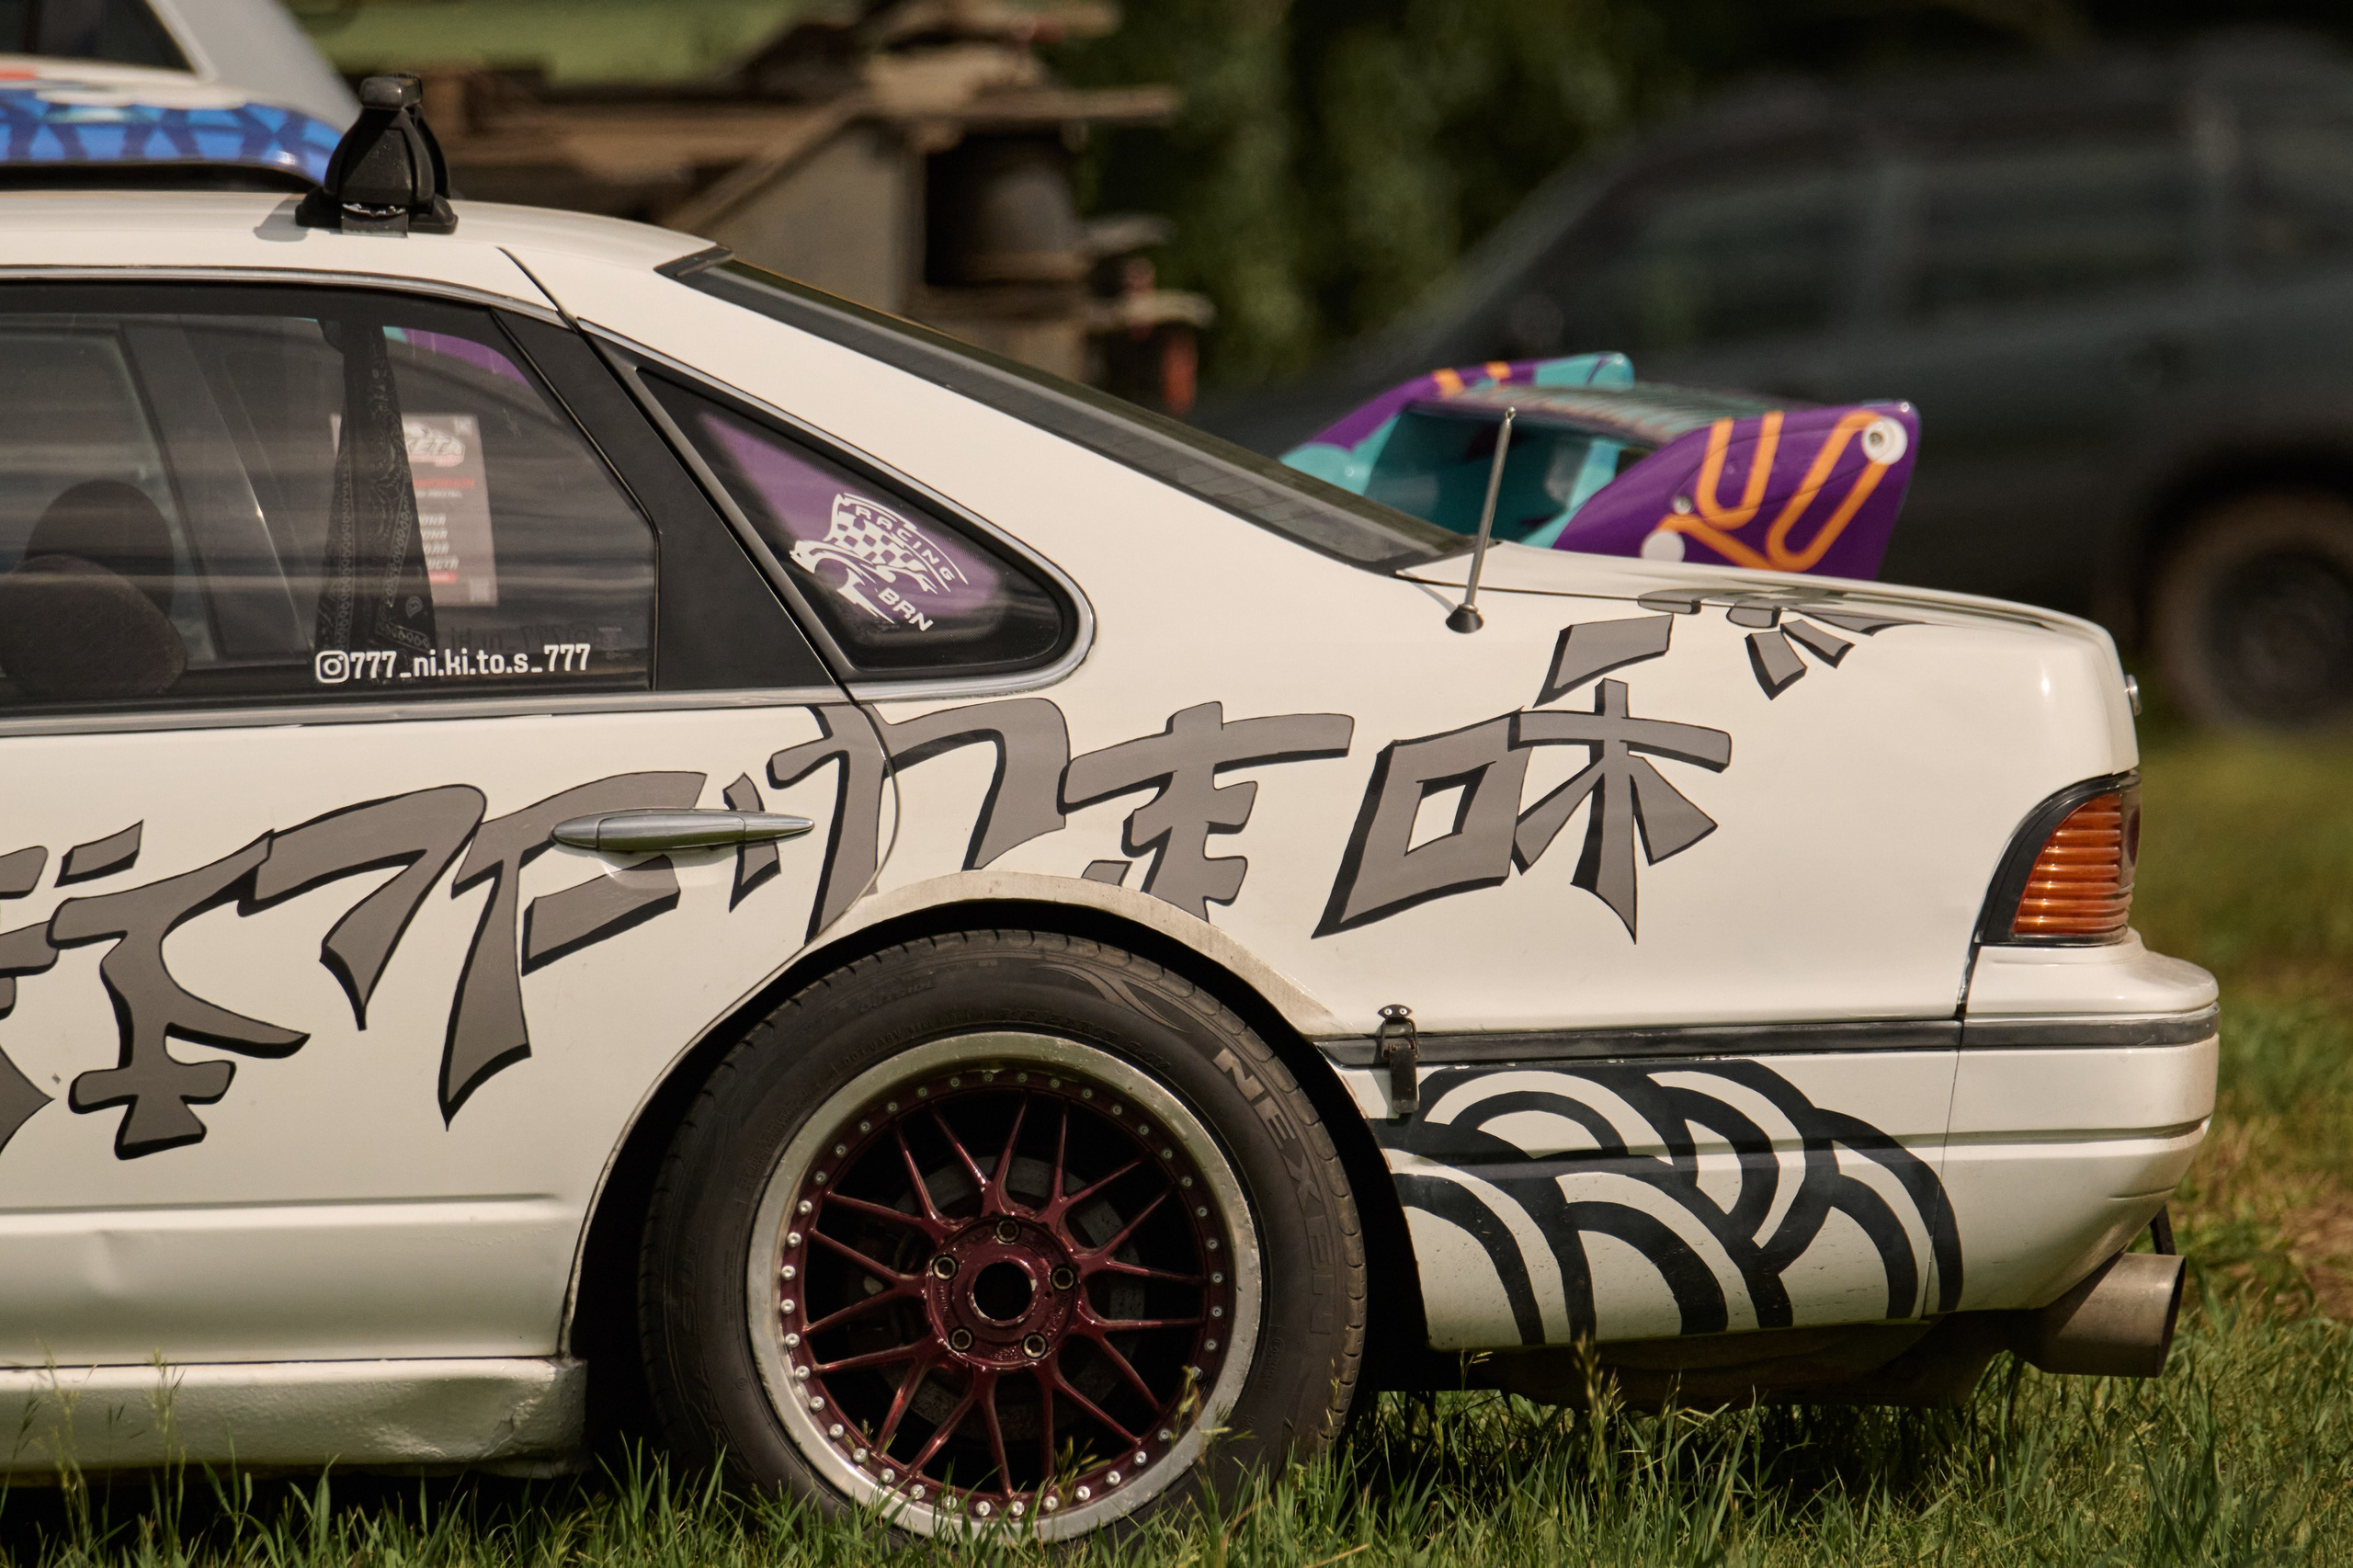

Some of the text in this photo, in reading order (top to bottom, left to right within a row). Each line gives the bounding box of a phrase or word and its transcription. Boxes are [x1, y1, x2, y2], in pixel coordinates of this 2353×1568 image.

[855, 505, 956, 582] RACING
[878, 587, 934, 632] BRN
[349, 642, 591, 680] 777_ni.ki.to.s_777
[1212, 1047, 1333, 1335] NEXEN
